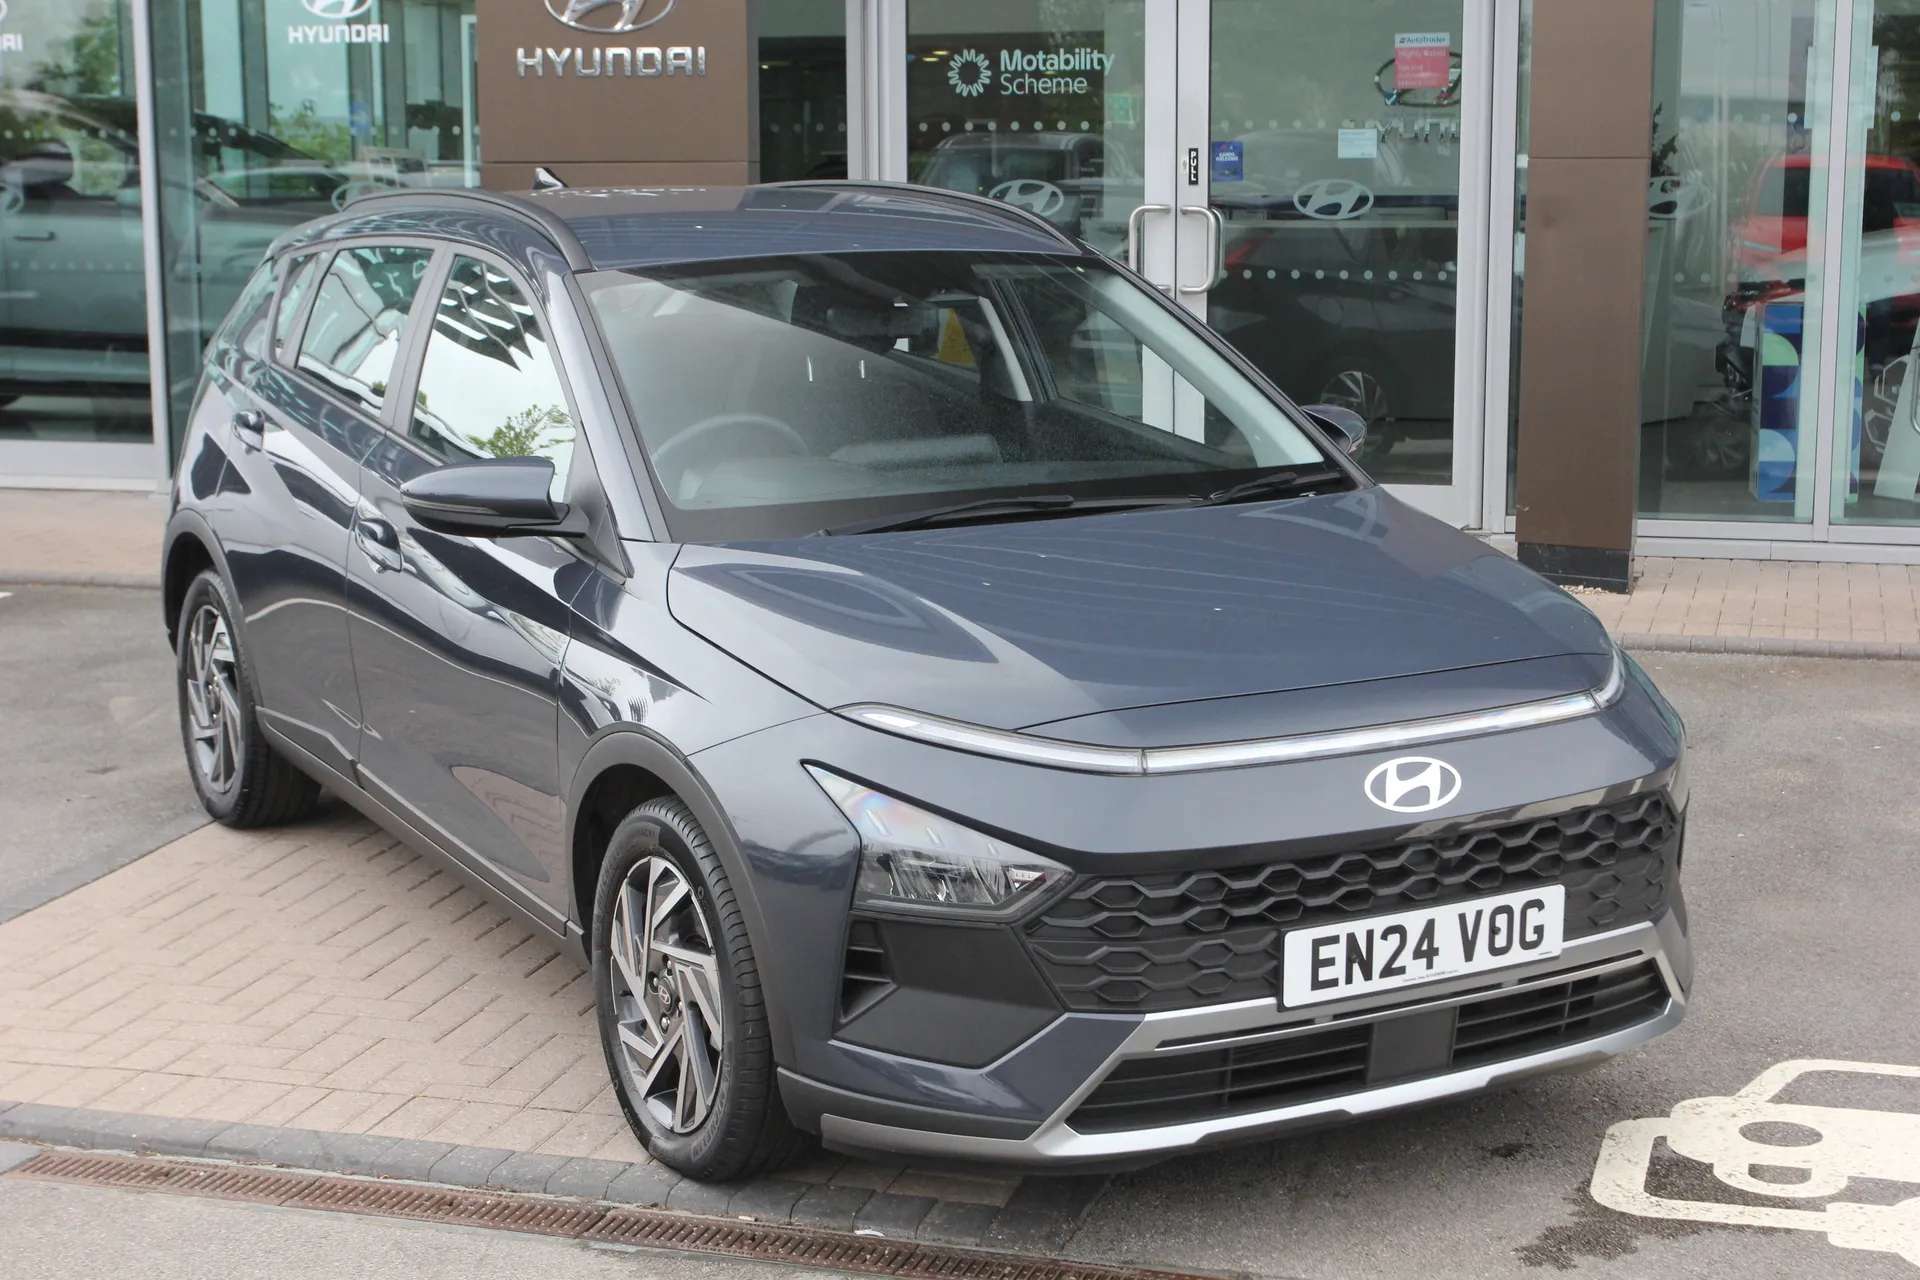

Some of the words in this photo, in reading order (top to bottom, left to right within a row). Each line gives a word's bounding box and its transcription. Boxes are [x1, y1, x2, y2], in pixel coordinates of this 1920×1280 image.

[288, 24, 389, 43] HYUNDAI
[516, 46, 706, 77] HYUNDAI
[1000, 48, 1115, 76] Motability
[1000, 73, 1088, 95] Scheme
[1311, 918, 1439, 991] EN24
[1458, 898, 1545, 963] VOG
